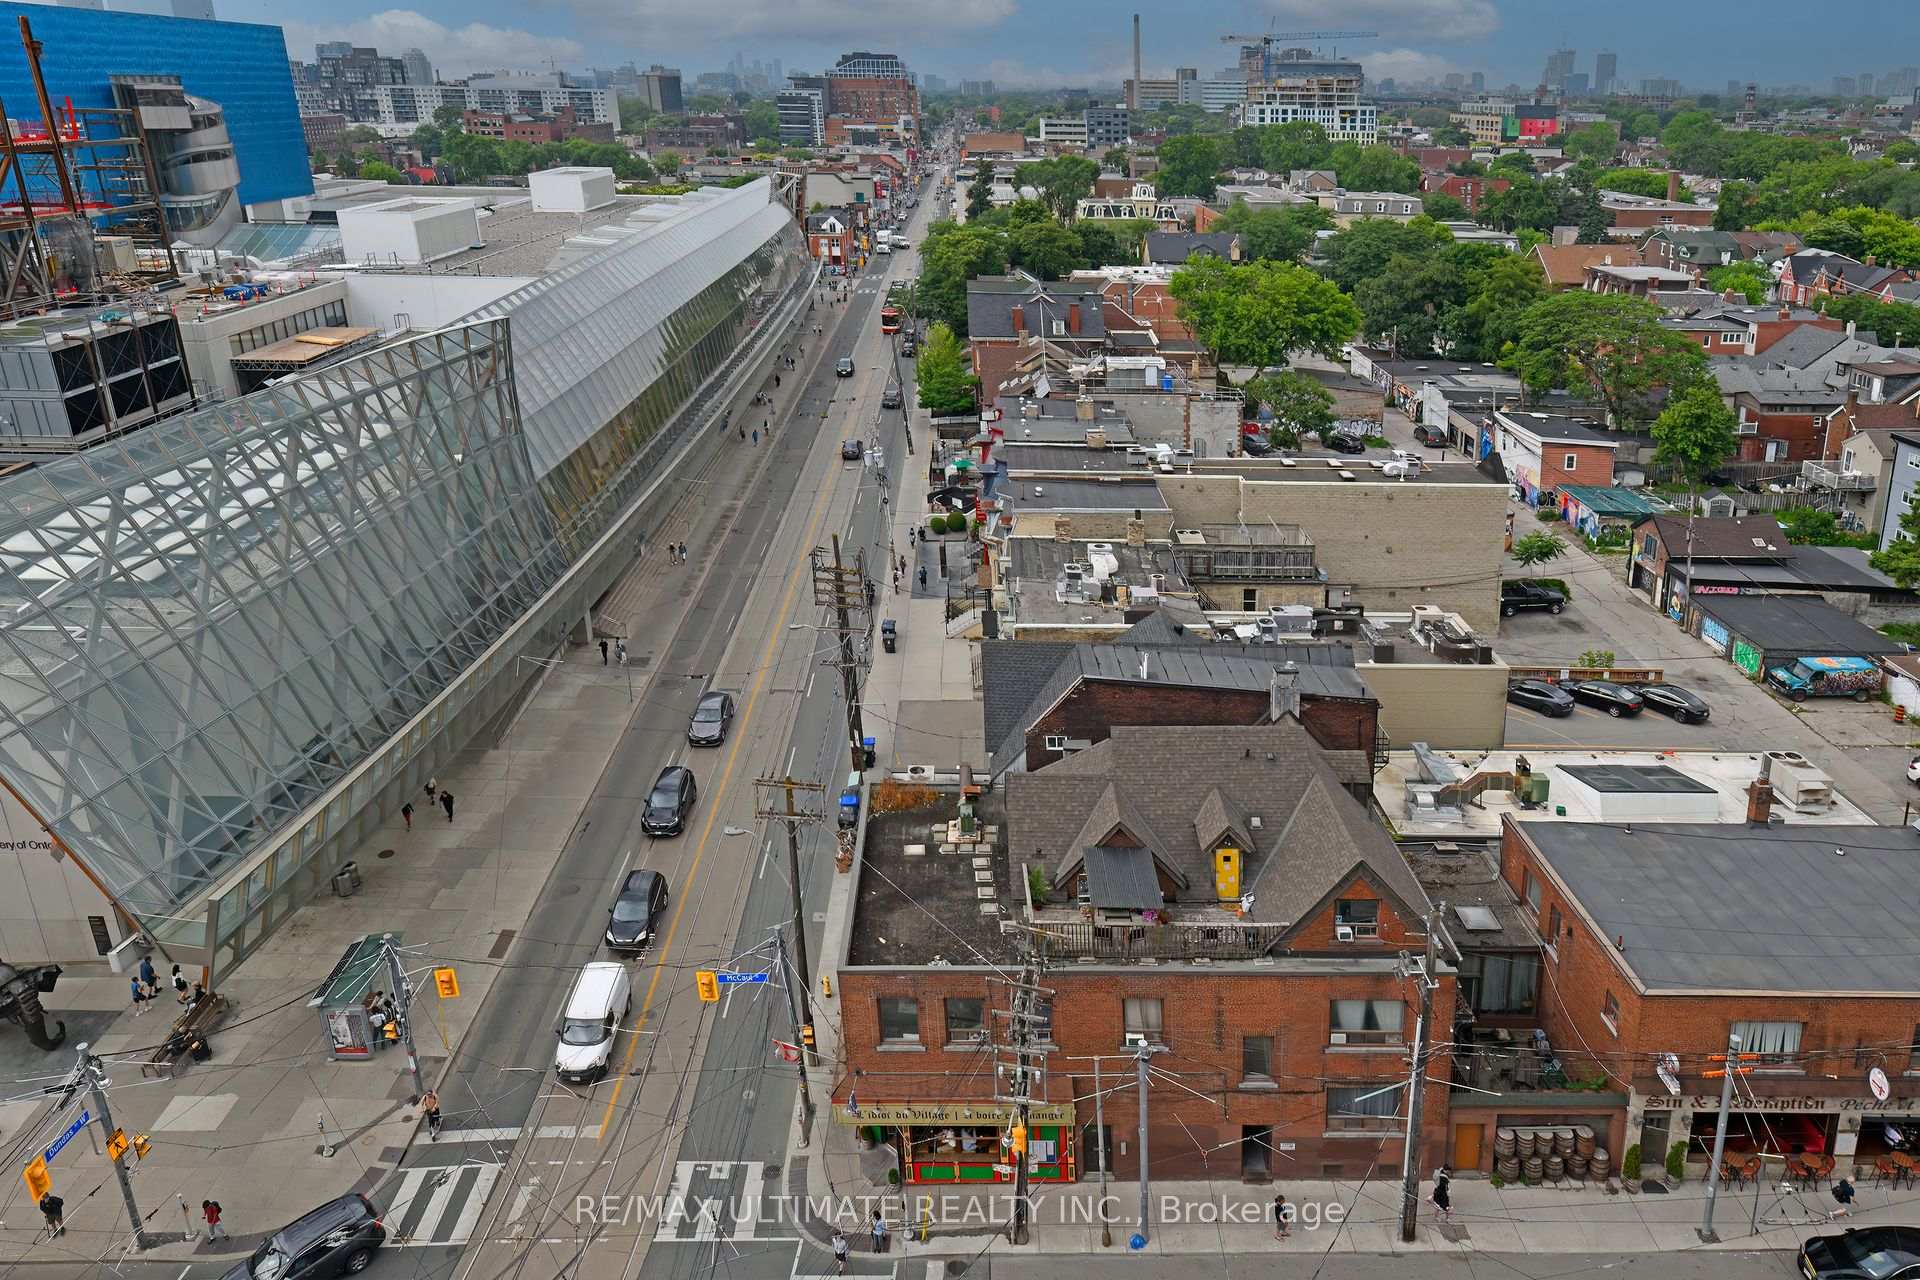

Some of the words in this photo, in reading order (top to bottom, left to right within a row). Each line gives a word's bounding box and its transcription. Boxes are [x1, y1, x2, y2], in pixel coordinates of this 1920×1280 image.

[1645, 1096, 1683, 1108] Sin
[1690, 1096, 1708, 1108] &
[912, 1110, 950, 1120] Village
[49, 1130, 74, 1156] Dundas
